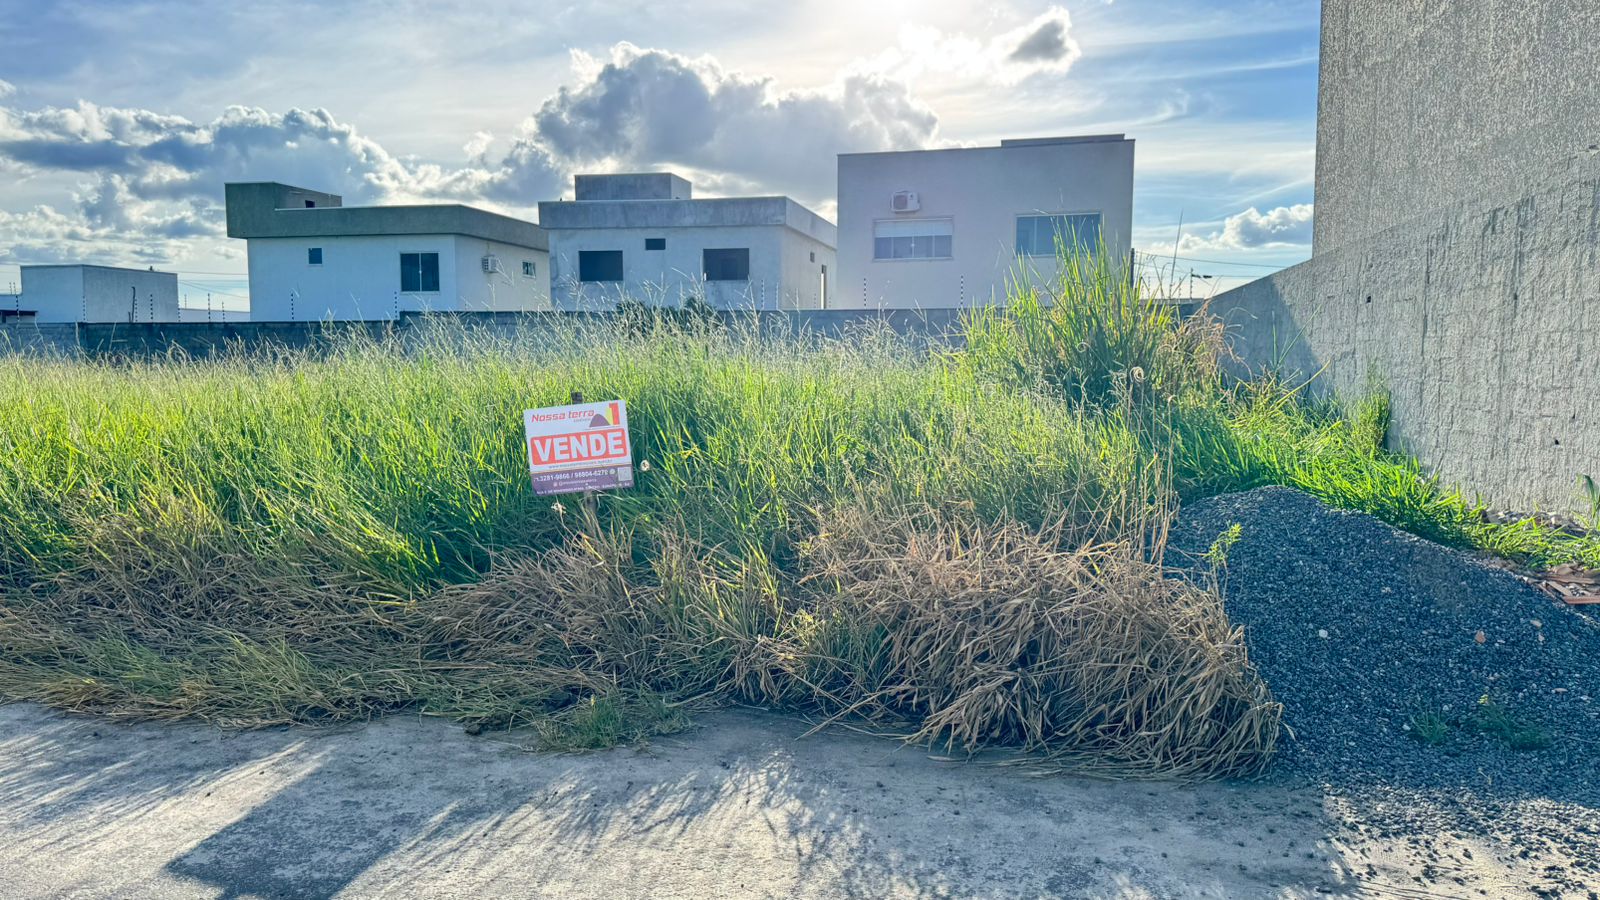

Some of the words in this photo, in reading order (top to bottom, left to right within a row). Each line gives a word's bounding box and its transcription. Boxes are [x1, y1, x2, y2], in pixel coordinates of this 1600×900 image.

[531, 413, 566, 422] Nossa
[568, 410, 595, 419] terra
[533, 432, 624, 462] VENDE
